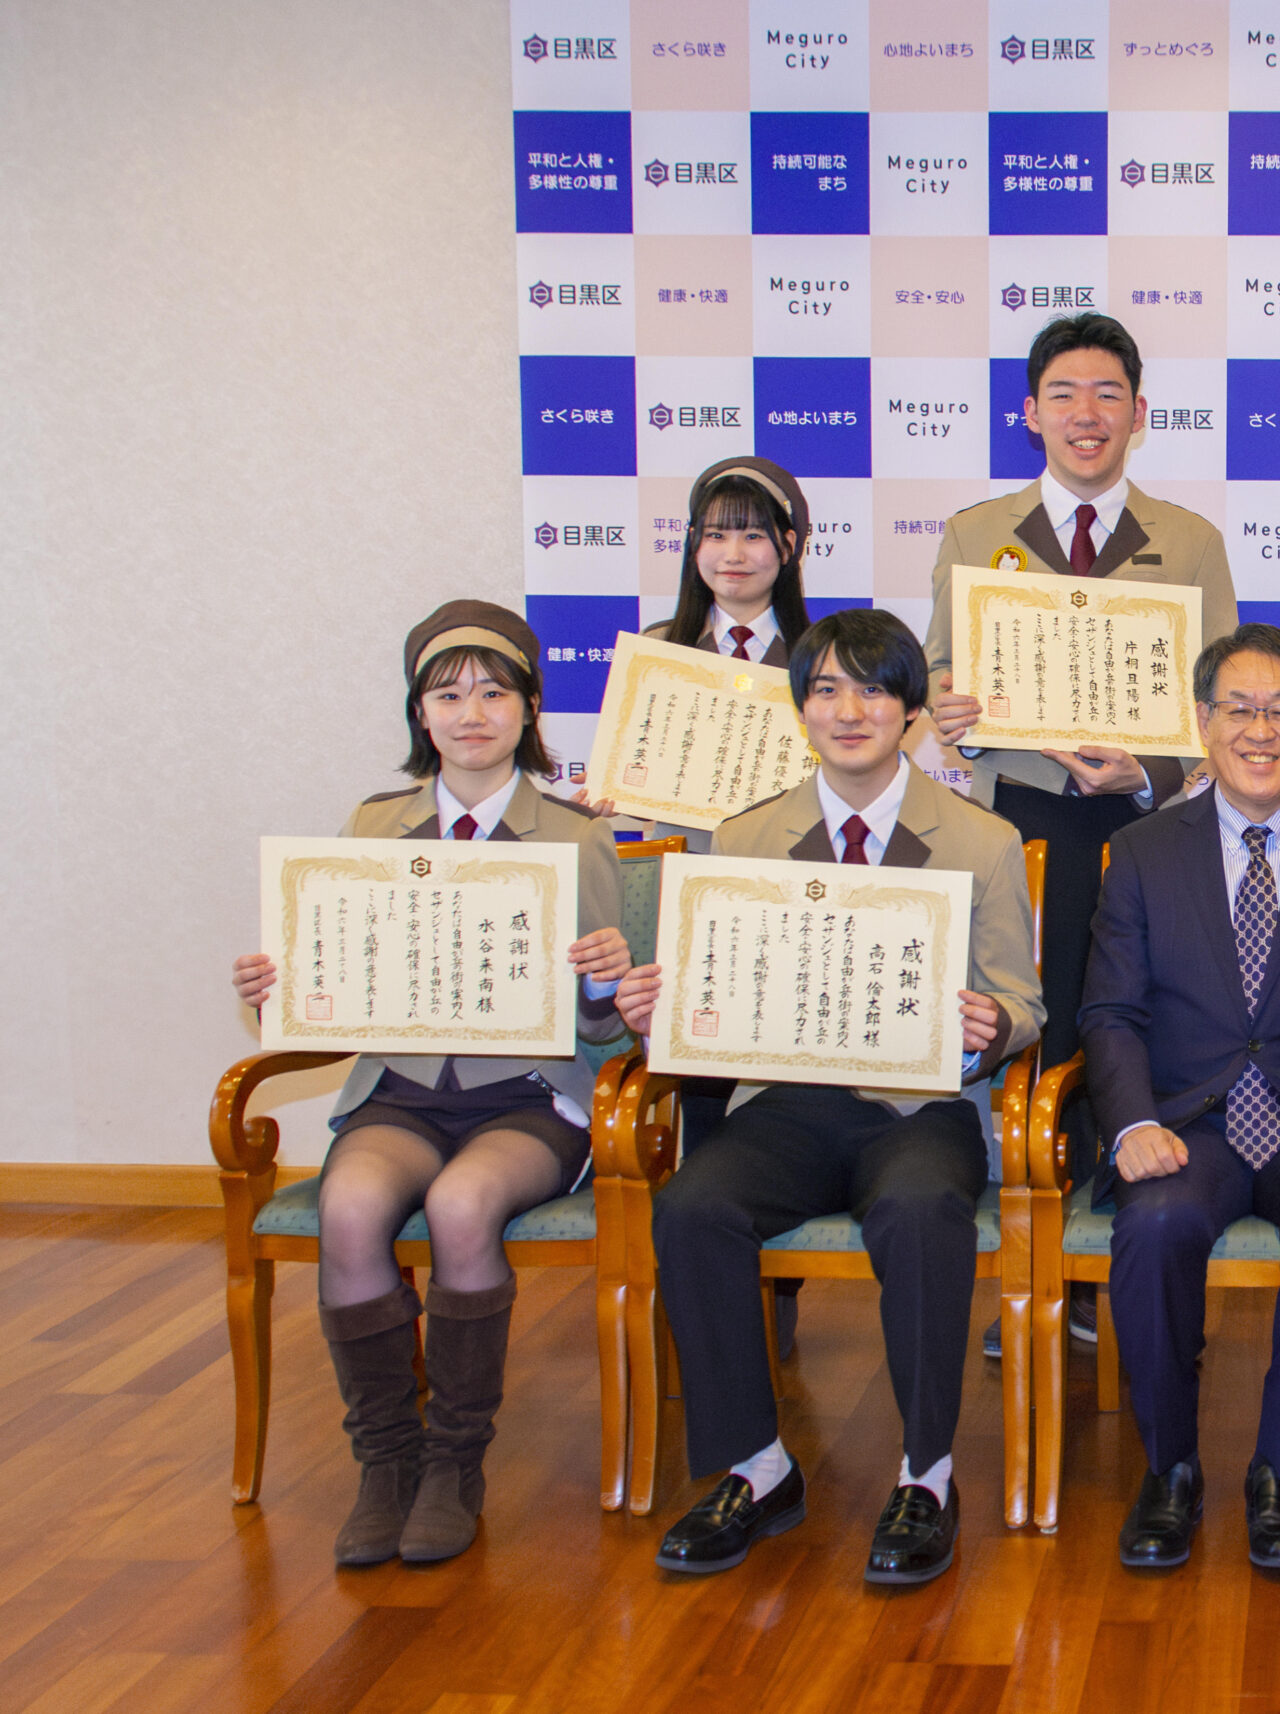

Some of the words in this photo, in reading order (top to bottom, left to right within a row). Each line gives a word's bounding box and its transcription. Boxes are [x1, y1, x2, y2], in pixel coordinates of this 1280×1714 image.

[768, 31, 847, 48] Meguro
[555, 39, 616, 59] 目黒区
[653, 42, 725, 56] さくら咲き
[884, 43, 973, 57] 心地よいまち
[1032, 39, 1094, 59] 目黒区
[1124, 42, 1213, 56] ずっとめぐろ
[786, 54, 829, 69] City
[773, 155, 847, 169] 持続可能な
[888, 156, 967, 173] Meguro
[676, 163, 737, 183] 目黒区
[1152, 163, 1214, 184] 目黒区
[529, 175, 617, 190] 多様性の尊重
[819, 176, 846, 191] まち
[906, 179, 949, 194] City
[1004, 176, 1092, 191] 多様性の尊重
[771, 278, 849, 294] Meguro
[560, 285, 621, 305] 目黒区
[658, 289, 727, 303] 健康・快適
[896, 290, 964, 304] 安全・安心
[1033, 287, 1095, 307] 目黒区
[1132, 291, 1202, 304] 健康・快適
[789, 301, 831, 316] City
[541, 409, 613, 423] さくら咲き
[890, 400, 968, 416] Meguro
[680, 407, 741, 427] 目黒区
[768, 411, 856, 425] 心地よいまち
[1151, 410, 1213, 430] 目黒区
[907, 420, 951, 438] City
[564, 526, 625, 545] 目黒区
[807, 521, 853, 536] guro
[806, 541, 834, 557] ity
[991, 647, 1007, 700] 青木英二
[1150, 638, 1169, 696] 感謝状
[771, 735, 793, 791] 佐藤優衣
[780, 912, 790, 943] ました
[508, 910, 531, 980] 感謝状
[311, 940, 326, 1001] 青木英二
[896, 939, 925, 1016] 感謝状
[699, 949, 717, 1016] 青木英二
